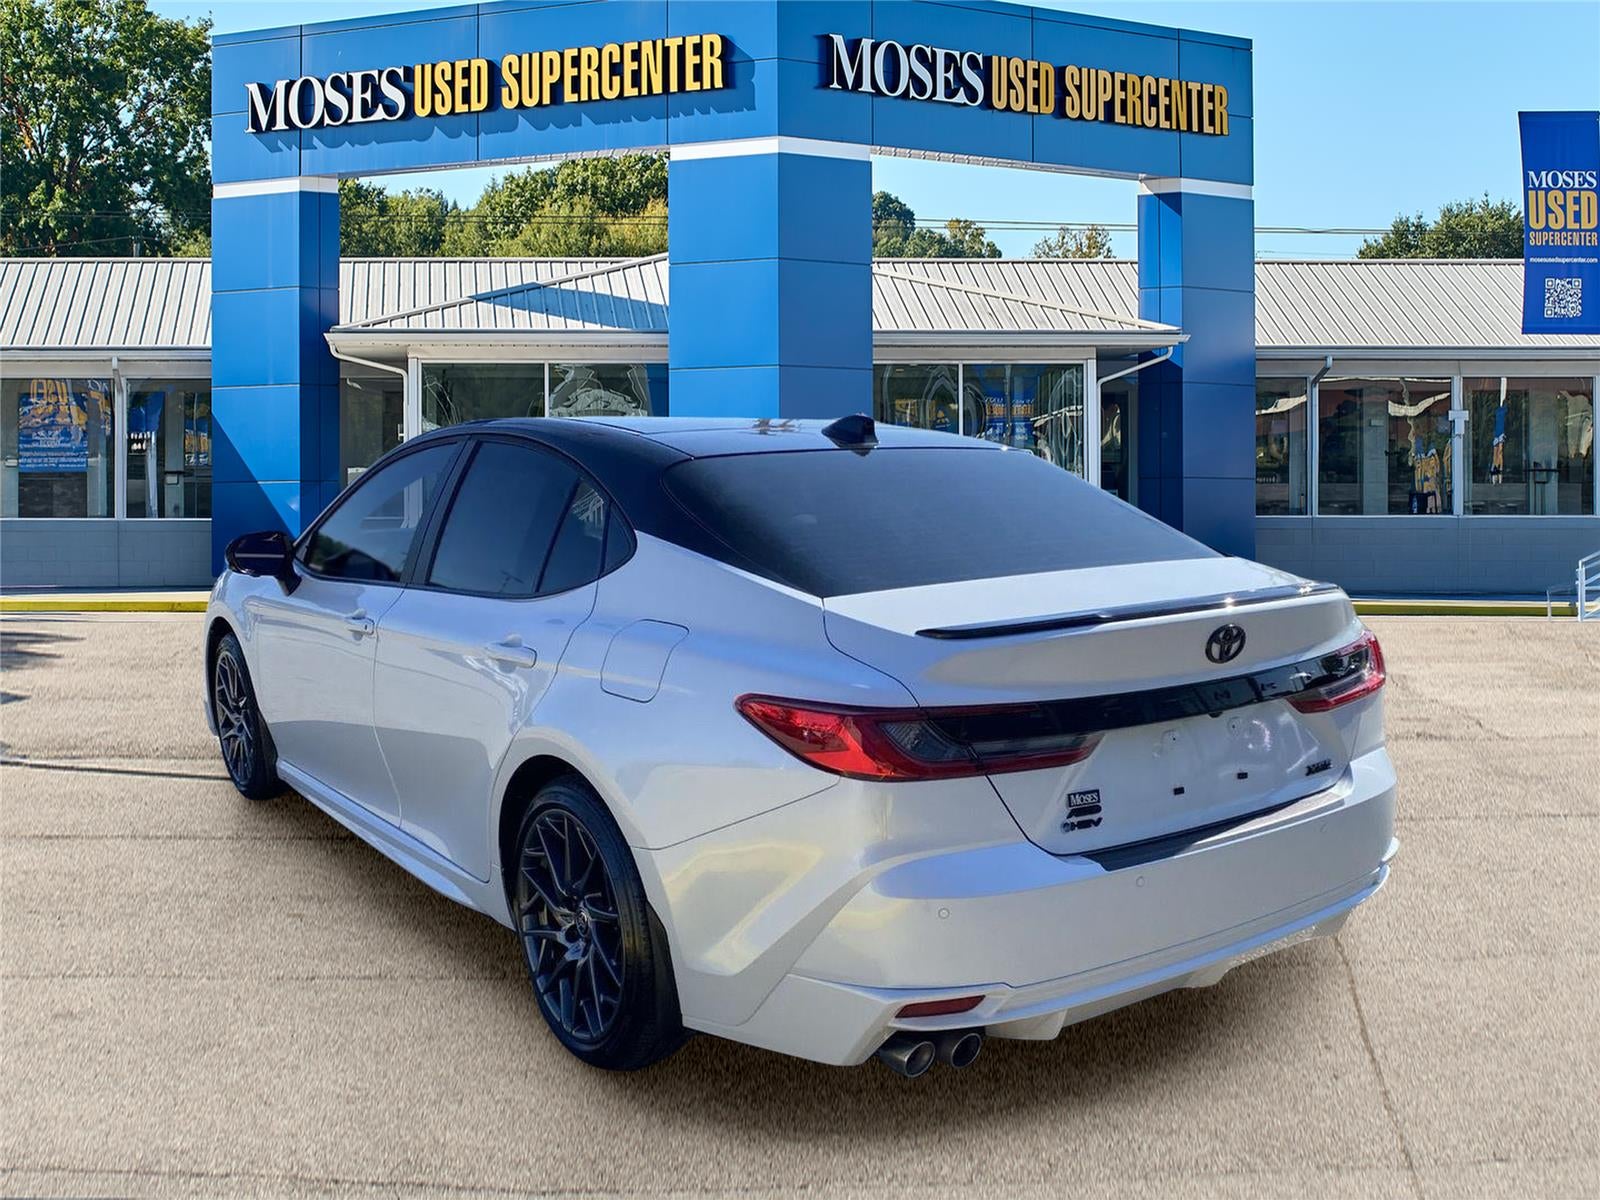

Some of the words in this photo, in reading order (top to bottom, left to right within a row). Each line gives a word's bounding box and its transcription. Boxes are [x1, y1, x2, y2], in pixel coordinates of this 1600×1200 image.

[245, 66, 406, 133] MOSES
[413, 58, 489, 117] USED
[501, 33, 723, 110] SUPERCENTER
[829, 33, 985, 107] MOSES
[991, 55, 1056, 114] USED
[1064, 64, 1229, 136] SUPERCENTER
[1528, 170, 1598, 189] MOSES
[1528, 190, 1598, 229] USED
[1529, 231, 1598, 246] SUPERCENTER
[1529, 256, 1598, 264] mosesusedsupercenter.com
